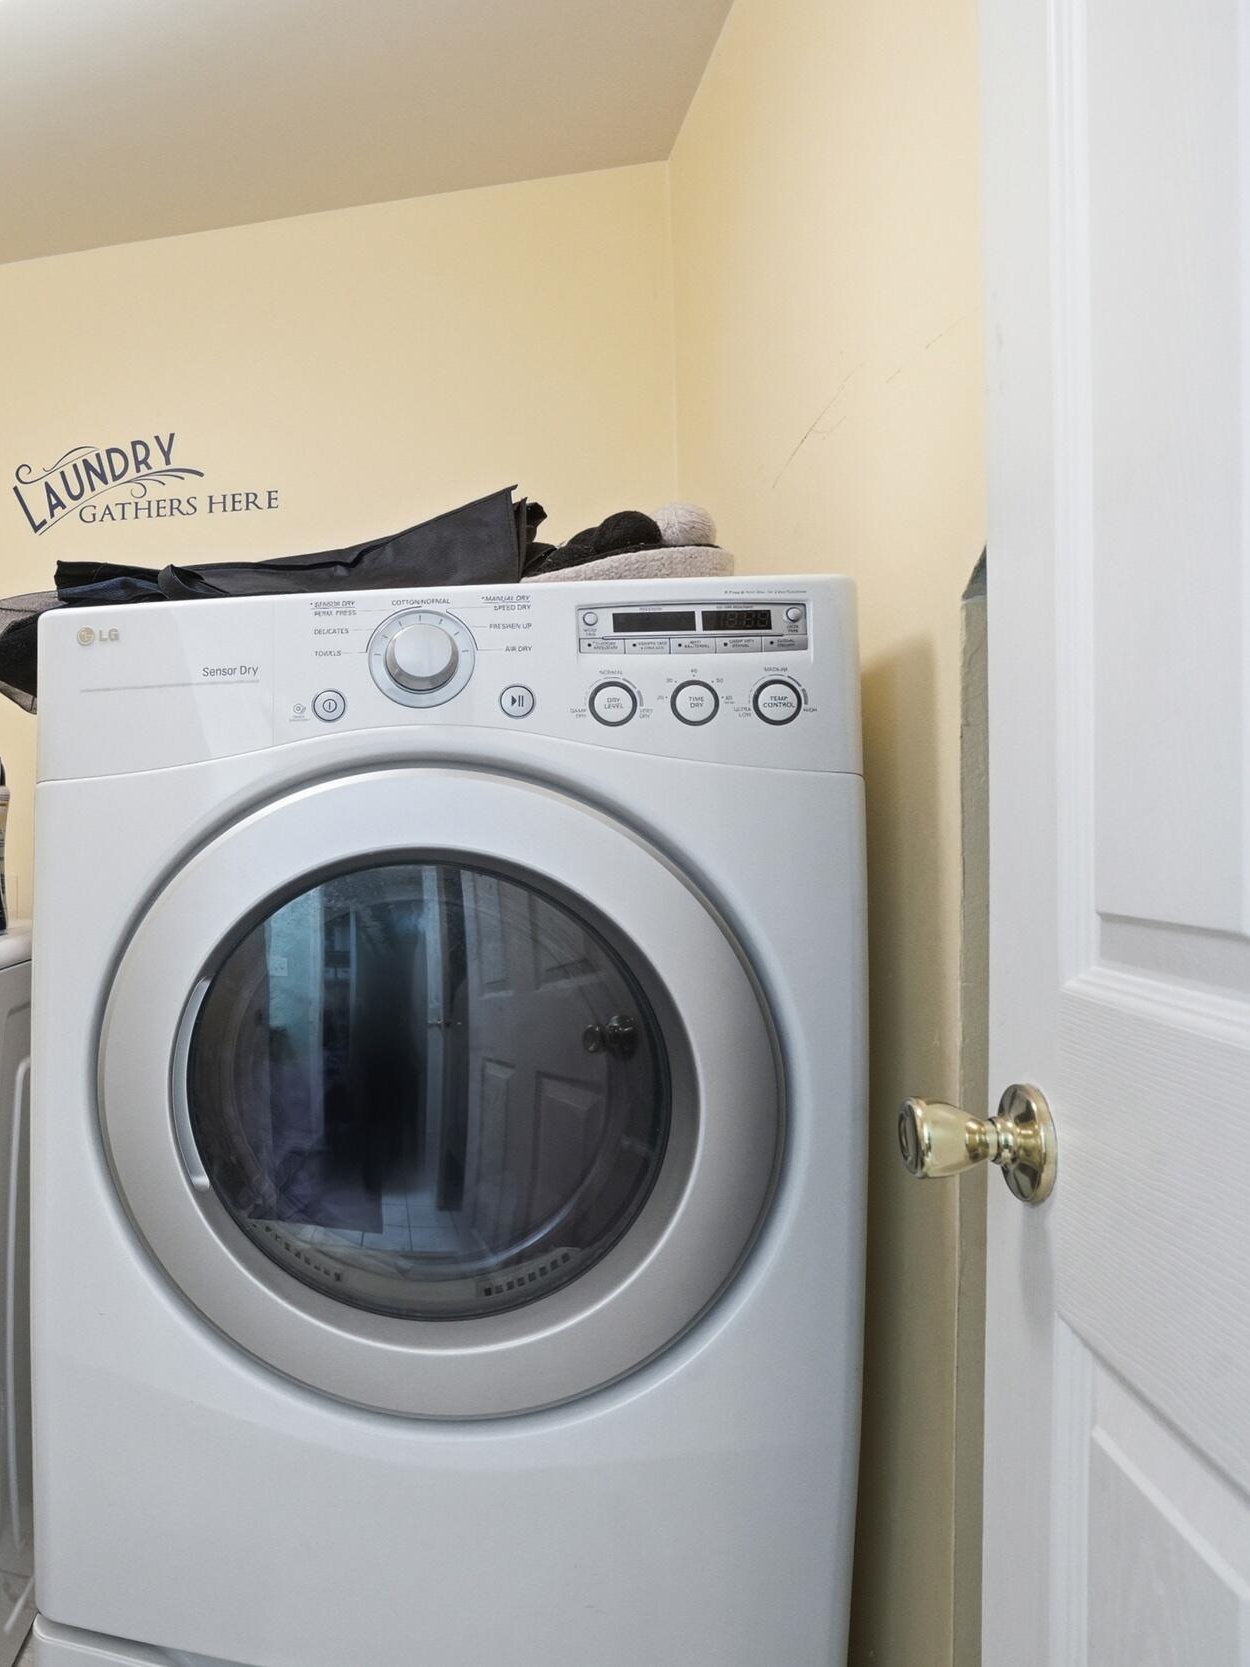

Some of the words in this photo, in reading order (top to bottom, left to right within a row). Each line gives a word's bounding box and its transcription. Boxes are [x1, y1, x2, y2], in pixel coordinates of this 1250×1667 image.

[12, 432, 176, 534] LAUNDRY
[78, 496, 198, 524] GATHERS
[207, 490, 280, 514] HERE
[98, 628, 120, 642] LG
[313, 627, 350, 636] DELICATES
[202, 667, 238, 678] Sensor
[239, 665, 259, 677] Dry
[762, 701, 796, 709] CONTROL
